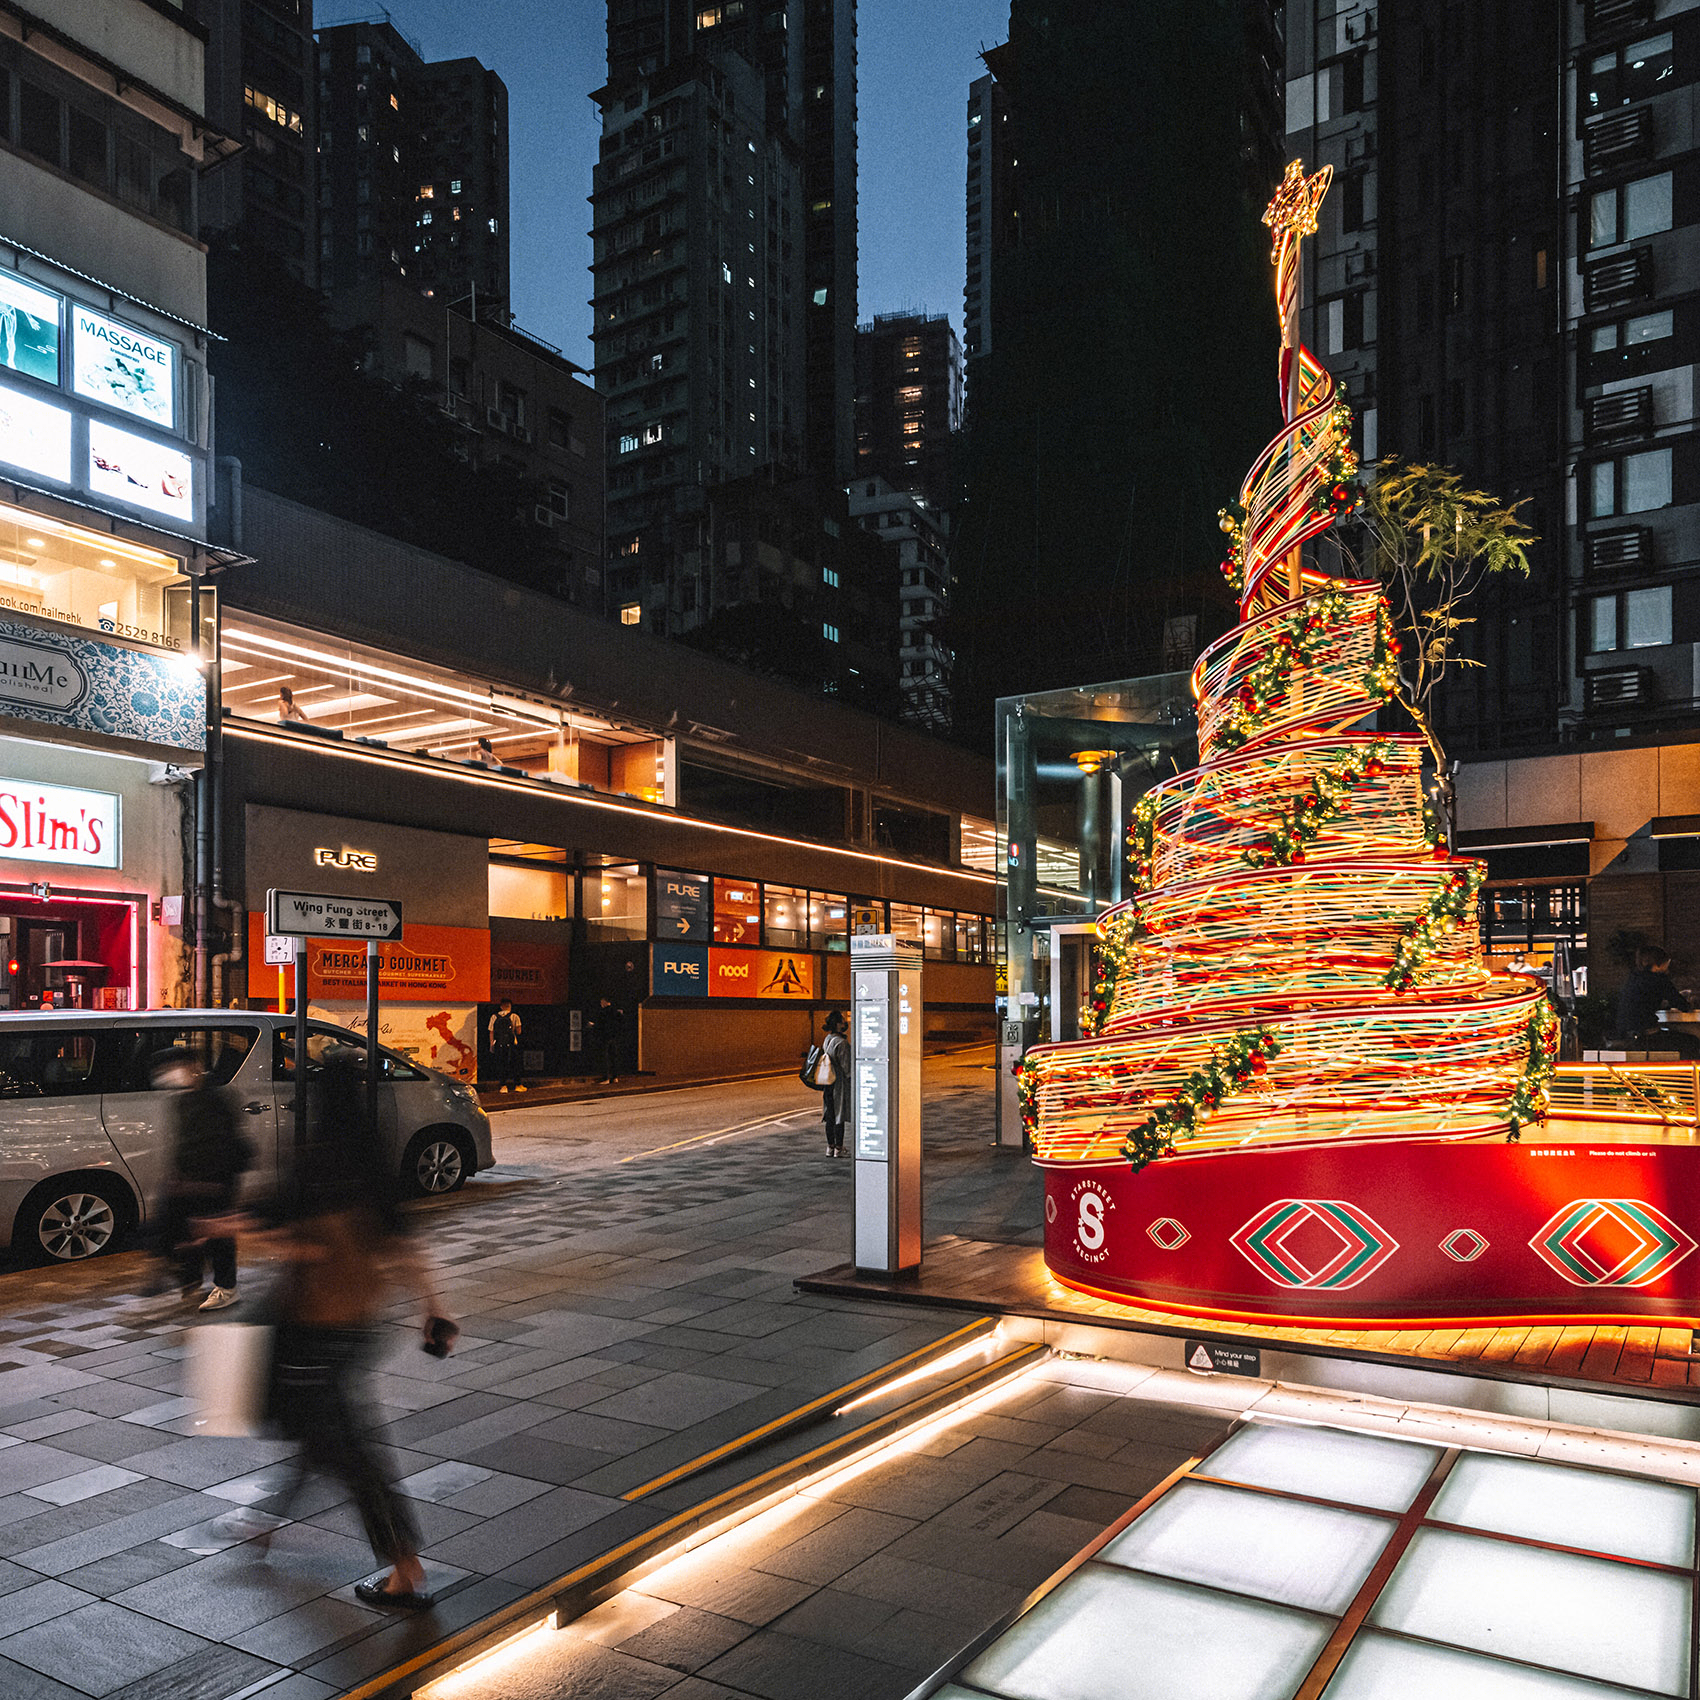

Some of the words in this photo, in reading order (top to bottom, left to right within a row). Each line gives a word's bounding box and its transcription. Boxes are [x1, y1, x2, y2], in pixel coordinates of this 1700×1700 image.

[80, 318, 167, 366] MASSAGE
[117, 622, 148, 641] 2529
[151, 631, 181, 649] 8166
[318, 849, 376, 870] PURE
[667, 883, 700, 897] PURE
[294, 901, 323, 914] Wing
[326, 904, 353, 917] Fung
[356, 907, 388, 917] Street
[322, 953, 385, 969] MERCAO
[390, 956, 447, 972] GOURMET
[664, 961, 700, 975] PURE
[719, 963, 749, 978] nood
[1072, 1238, 1110, 1263] PRECINCT
[1214, 1349, 1230, 1358] Mind
